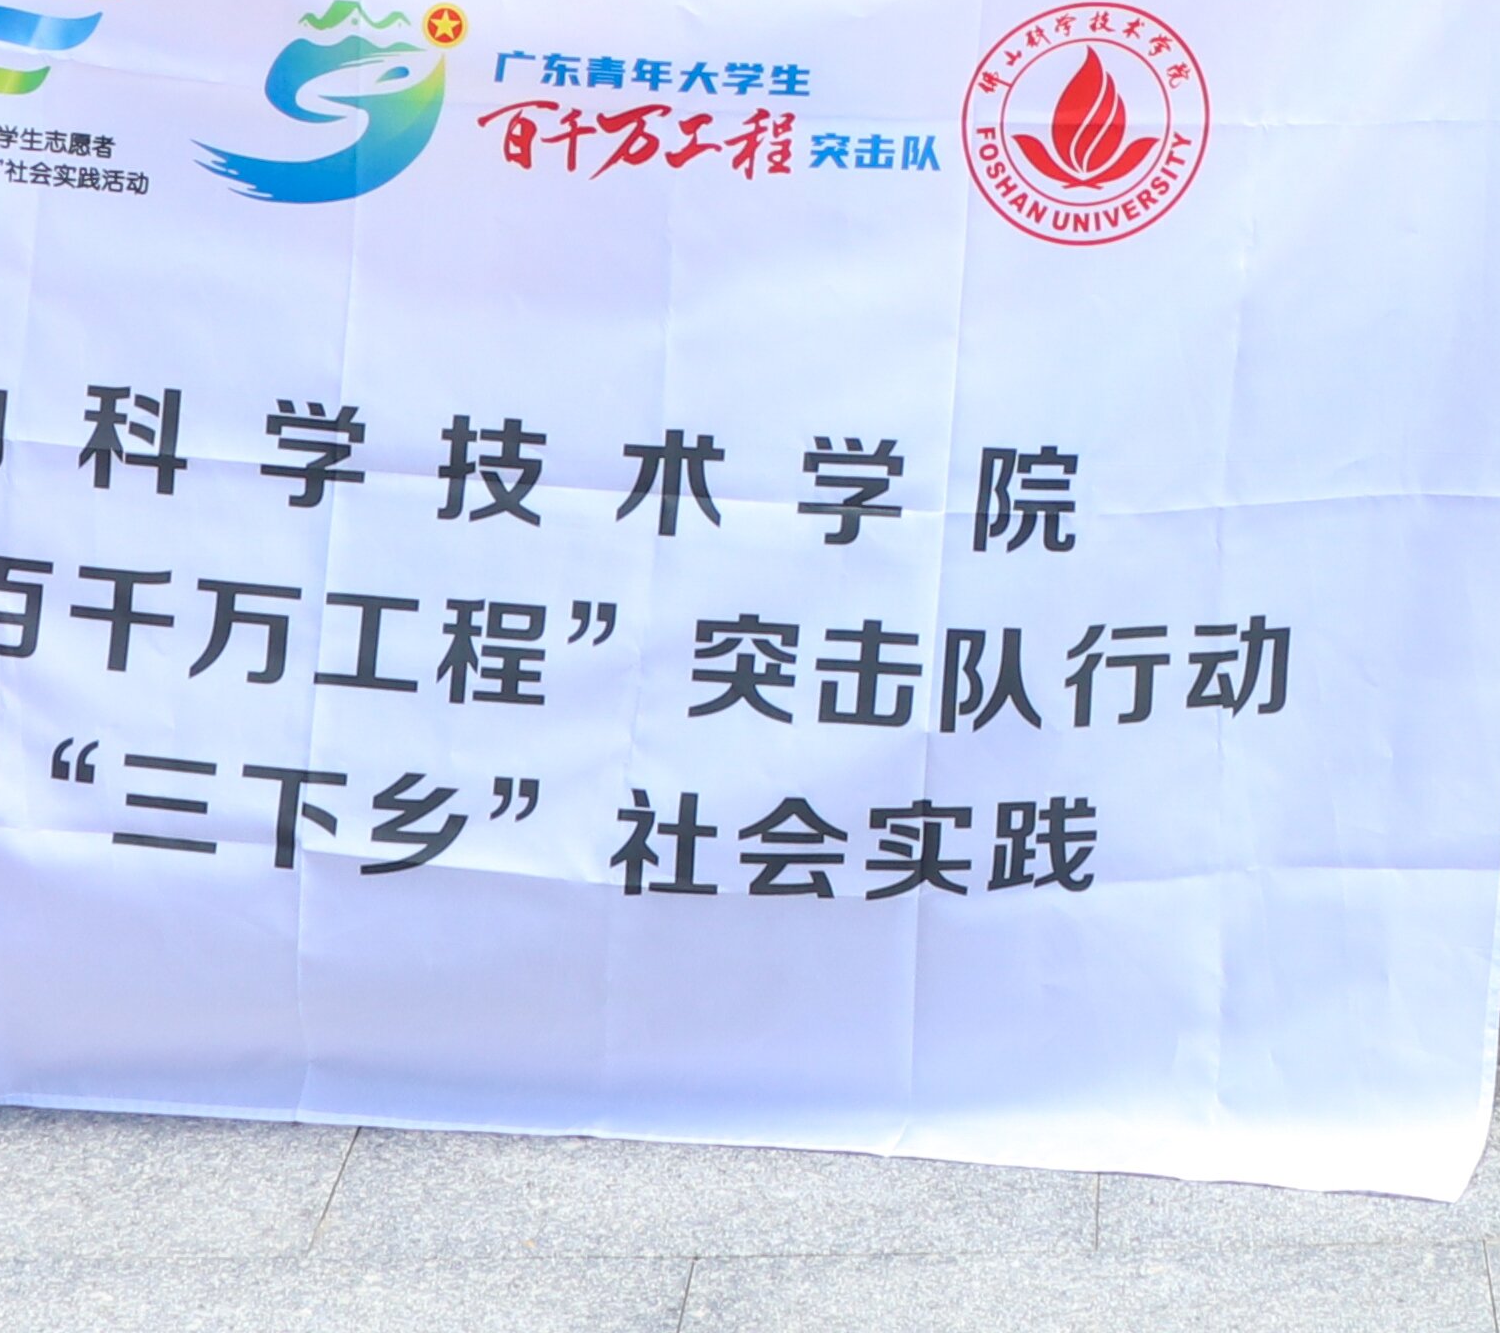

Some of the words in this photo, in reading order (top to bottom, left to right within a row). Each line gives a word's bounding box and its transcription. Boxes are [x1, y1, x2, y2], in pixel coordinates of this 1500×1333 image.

[493, 50, 812, 98] 广东青年大学生
[477, 98, 795, 181] 百千万工程
[807, 132, 943, 173] 突击队
[975, 126, 1048, 225] FOSHAN
[1051, 131, 1194, 234] UNIVERSITY
